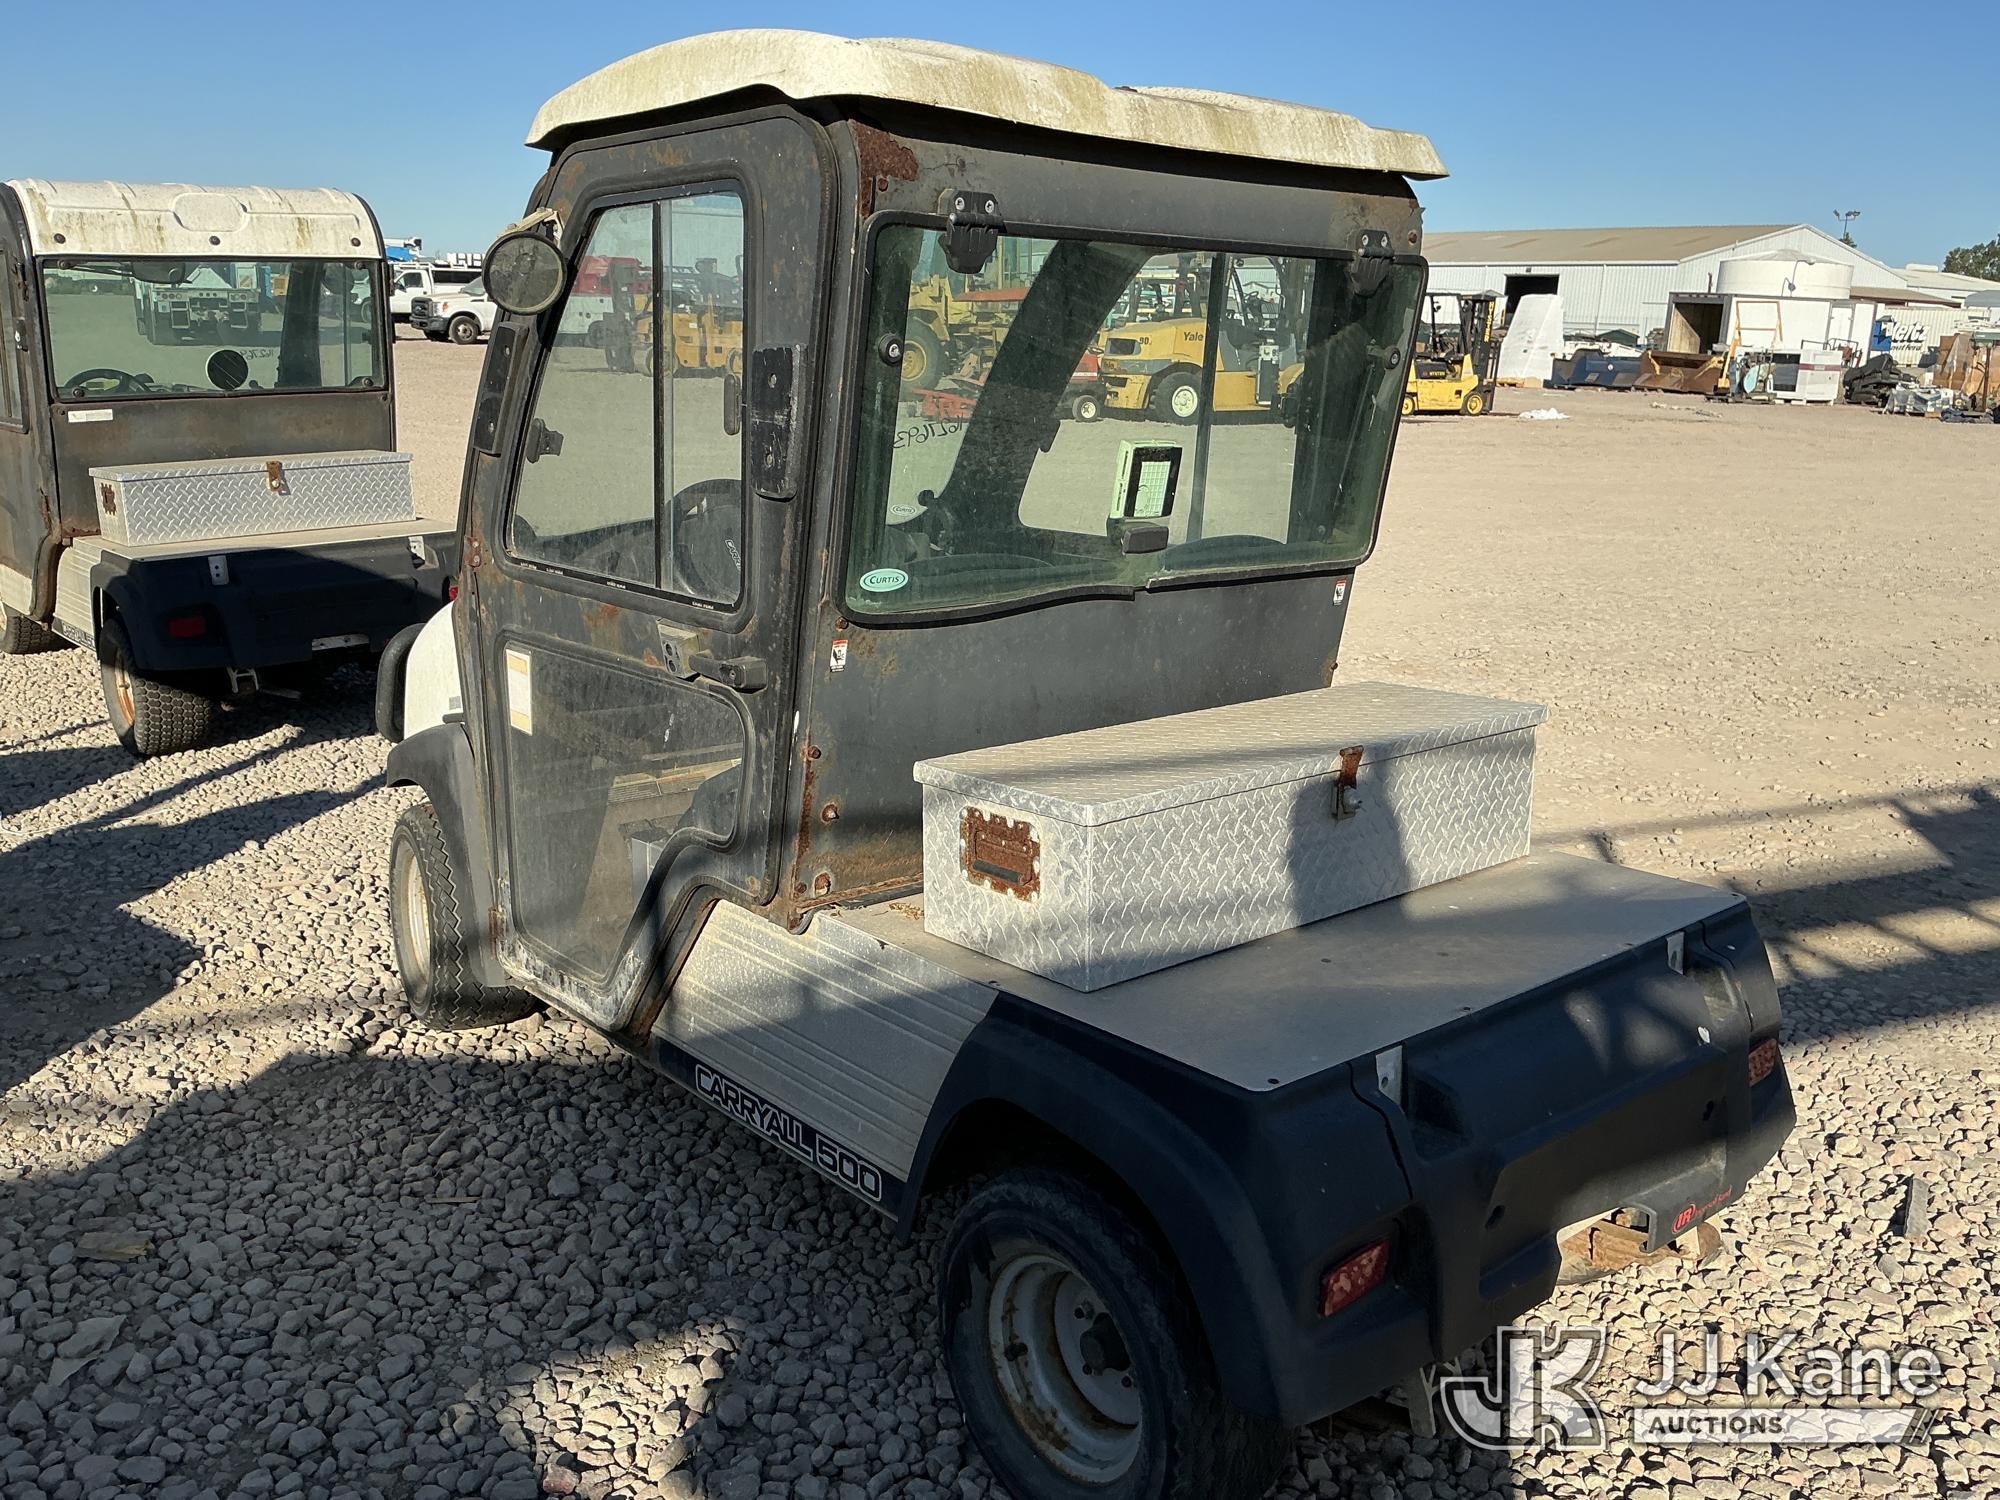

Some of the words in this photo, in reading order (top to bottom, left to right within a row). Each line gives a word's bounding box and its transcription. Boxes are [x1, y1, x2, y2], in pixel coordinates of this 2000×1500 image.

[1183, 331, 1204, 342] Yale
[1483, 301, 1495, 343] HYSTER
[695, 1063, 814, 1164] CARRYALL
[815, 1133, 883, 1202] 500
